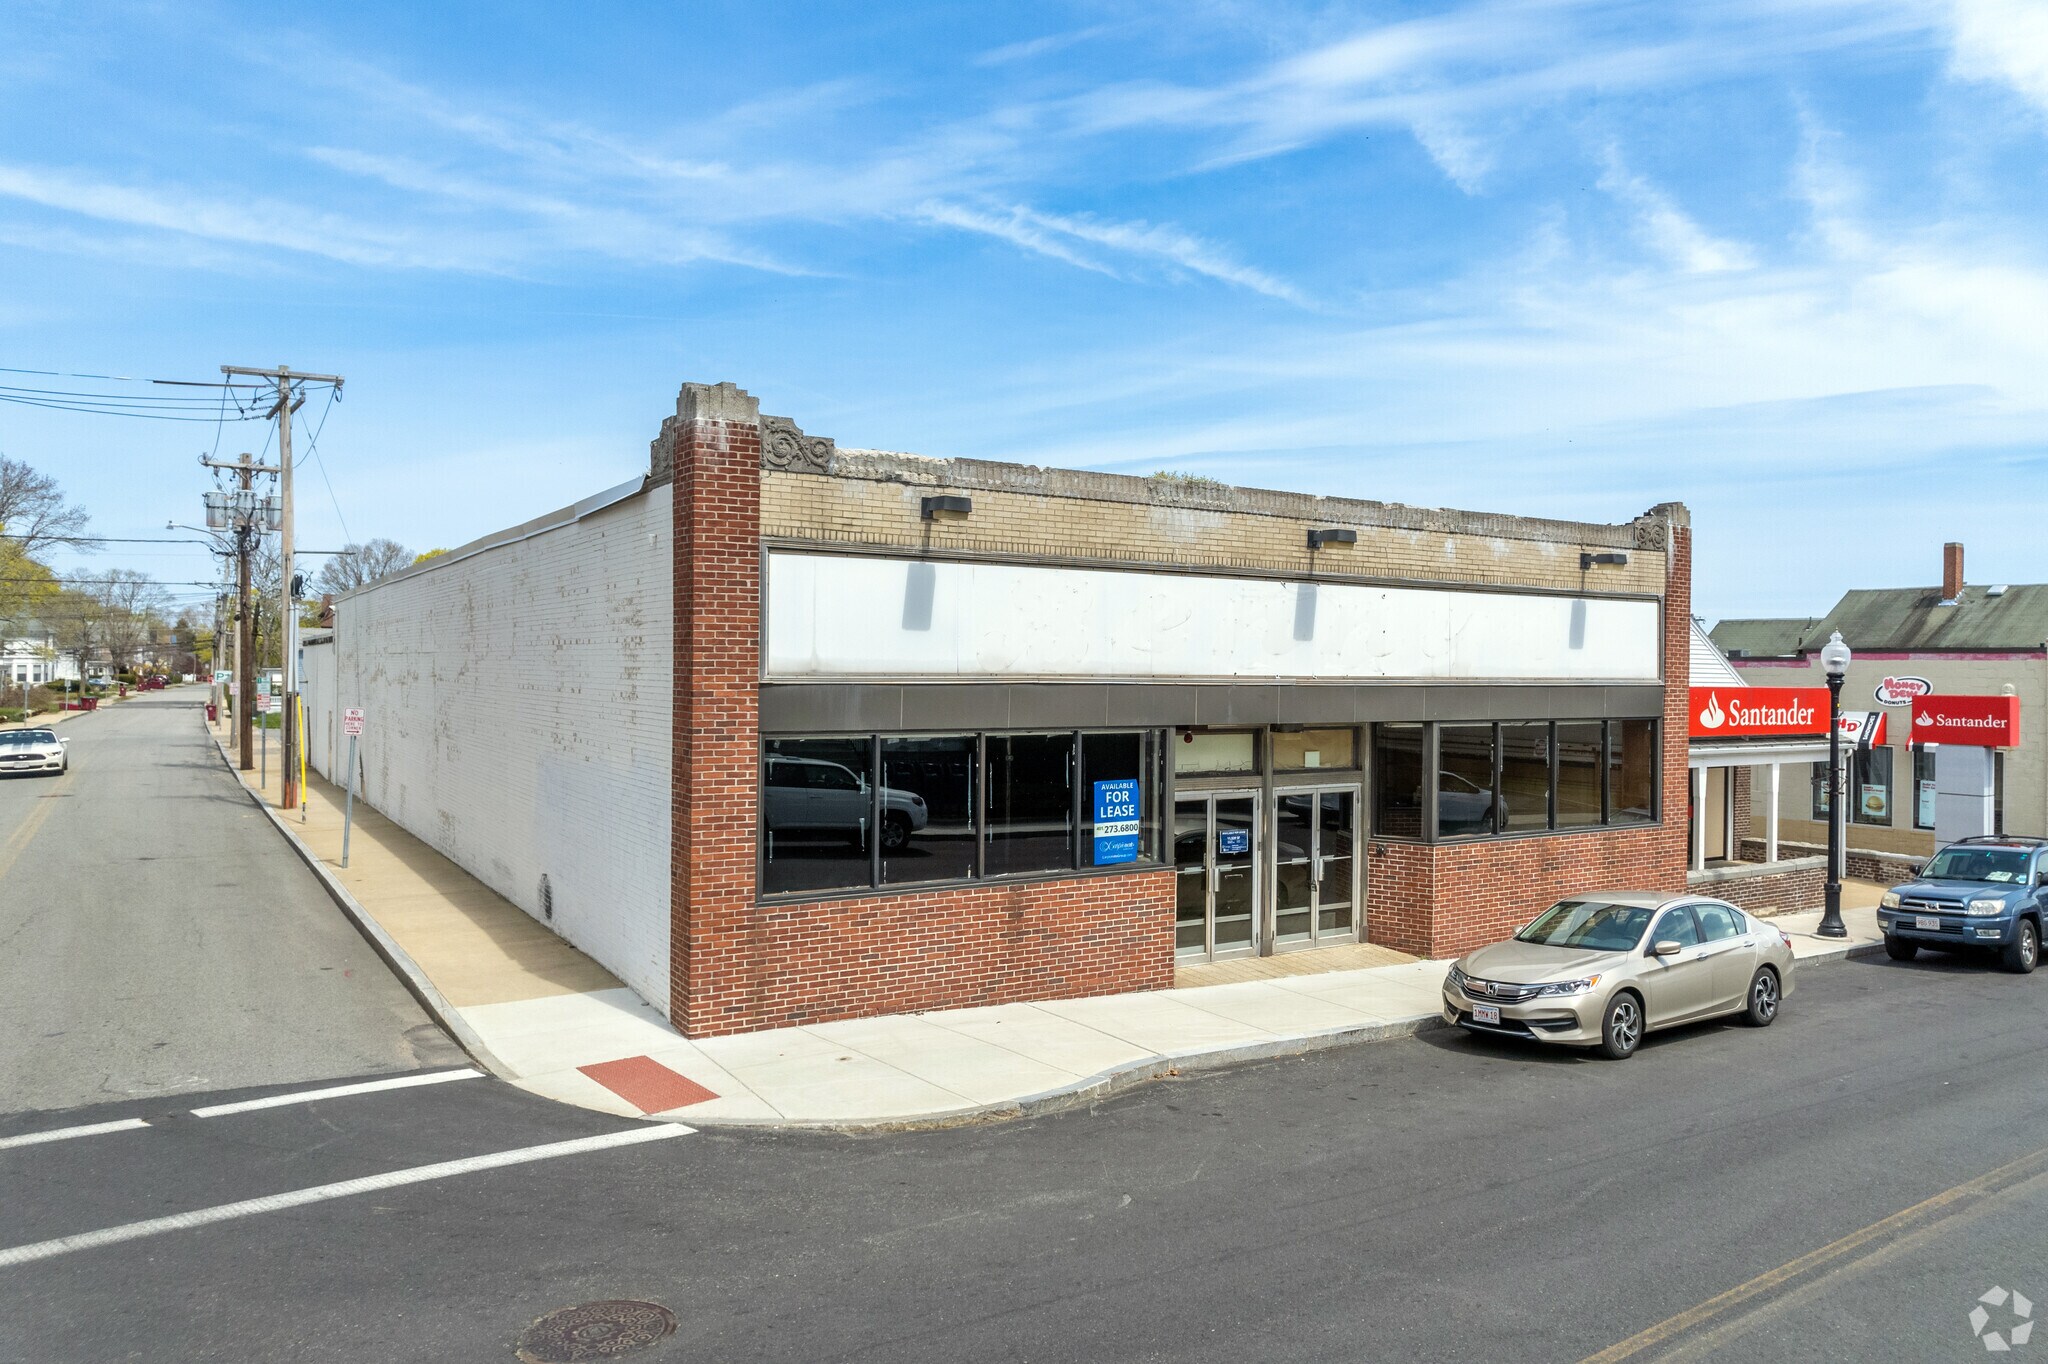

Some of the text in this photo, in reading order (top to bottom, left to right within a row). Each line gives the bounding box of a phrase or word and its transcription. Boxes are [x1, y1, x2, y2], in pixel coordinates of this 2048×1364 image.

[216, 673, 224, 681] P
[1883, 677, 1923, 691] HONEY
[1728, 697, 1815, 727] Santander
[1936, 713, 2008, 729] Santander
[1101, 782, 1134, 791] AVAILABLE
[1106, 790, 1129, 803] FOR
[1100, 804, 1135, 818] LEASE
